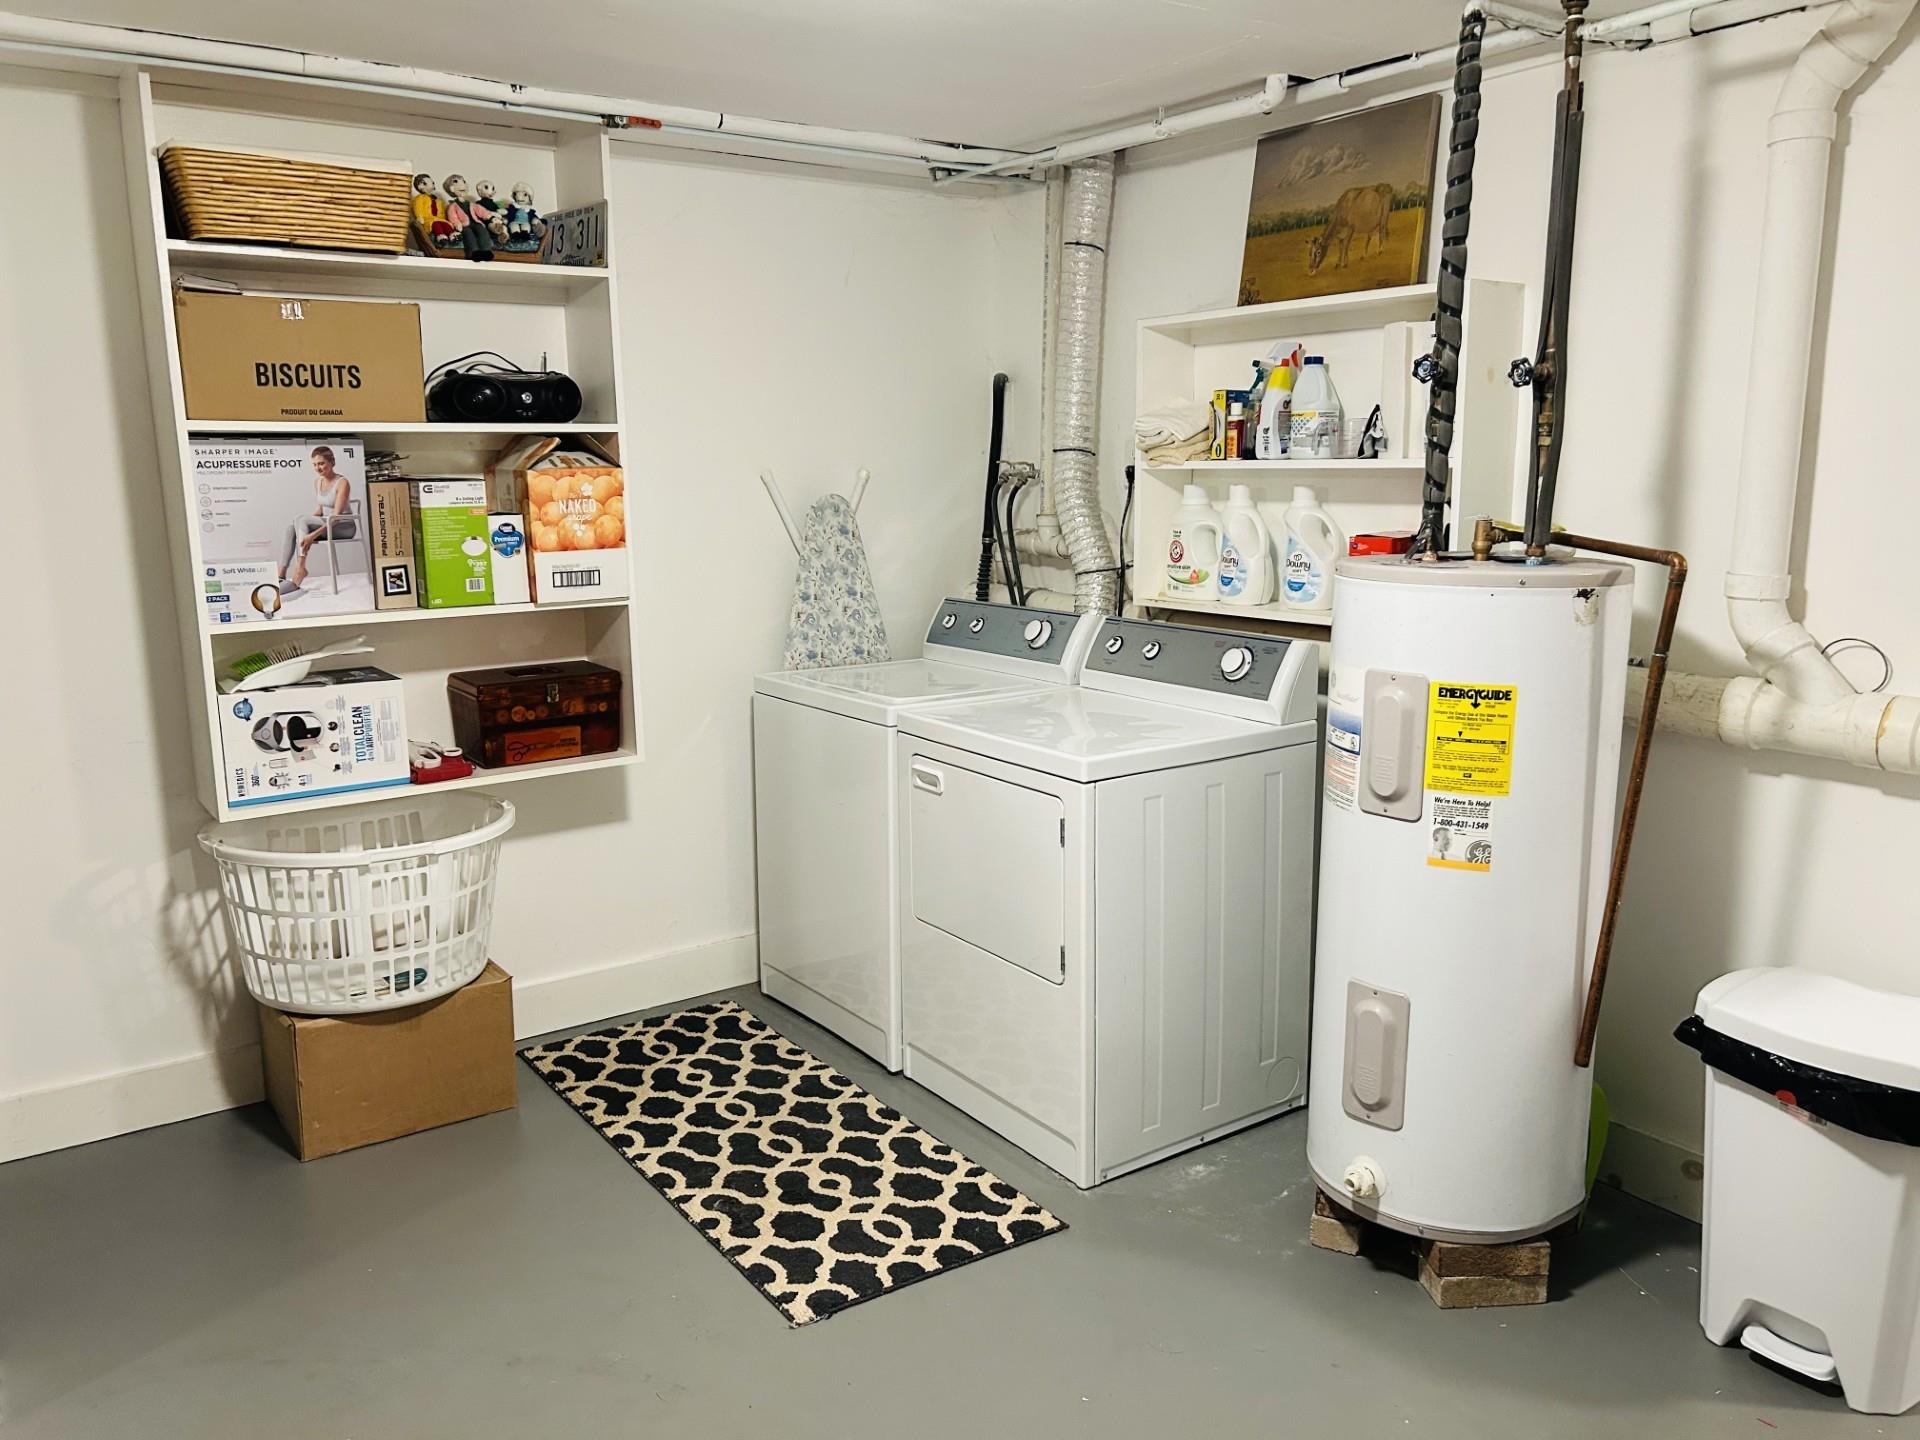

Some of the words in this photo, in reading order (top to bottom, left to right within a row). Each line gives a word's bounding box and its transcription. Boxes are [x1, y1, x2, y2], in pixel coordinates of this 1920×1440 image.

[255, 362, 361, 388] BISCUITS
[196, 460, 271, 469] ACUPRESSURE
[274, 460, 302, 468] FOOT
[559, 499, 596, 514] NAKED
[1286, 559, 1310, 571] Downy
[1438, 687, 1512, 702] ENERGYGUIDE
[1433, 818, 1489, 830] 1-800-431-1549
